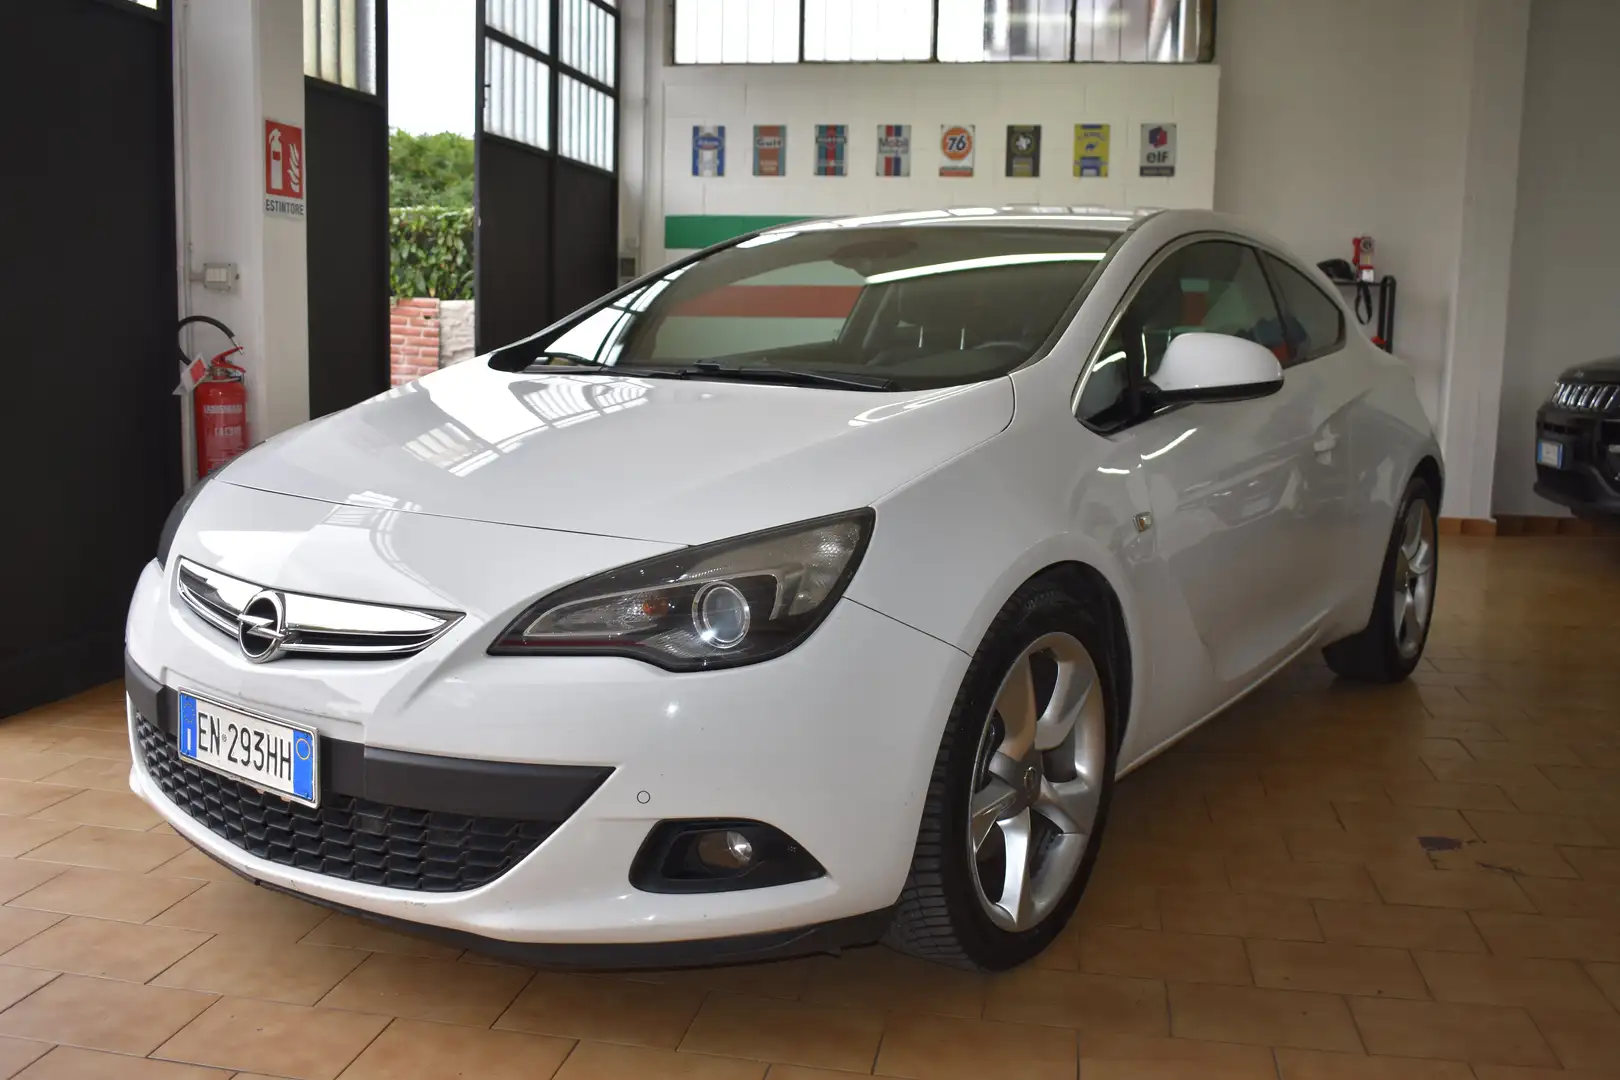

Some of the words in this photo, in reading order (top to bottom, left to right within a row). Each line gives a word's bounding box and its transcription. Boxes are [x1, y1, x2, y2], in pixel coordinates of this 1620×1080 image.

[757, 137, 782, 148] Gulf
[878, 137, 908, 147] Mobil
[947, 135, 966, 151] 76
[1146, 151, 1169, 163] elf
[265, 199, 304, 216] ESTINTORE
[227, 723, 293, 781] 293HH
